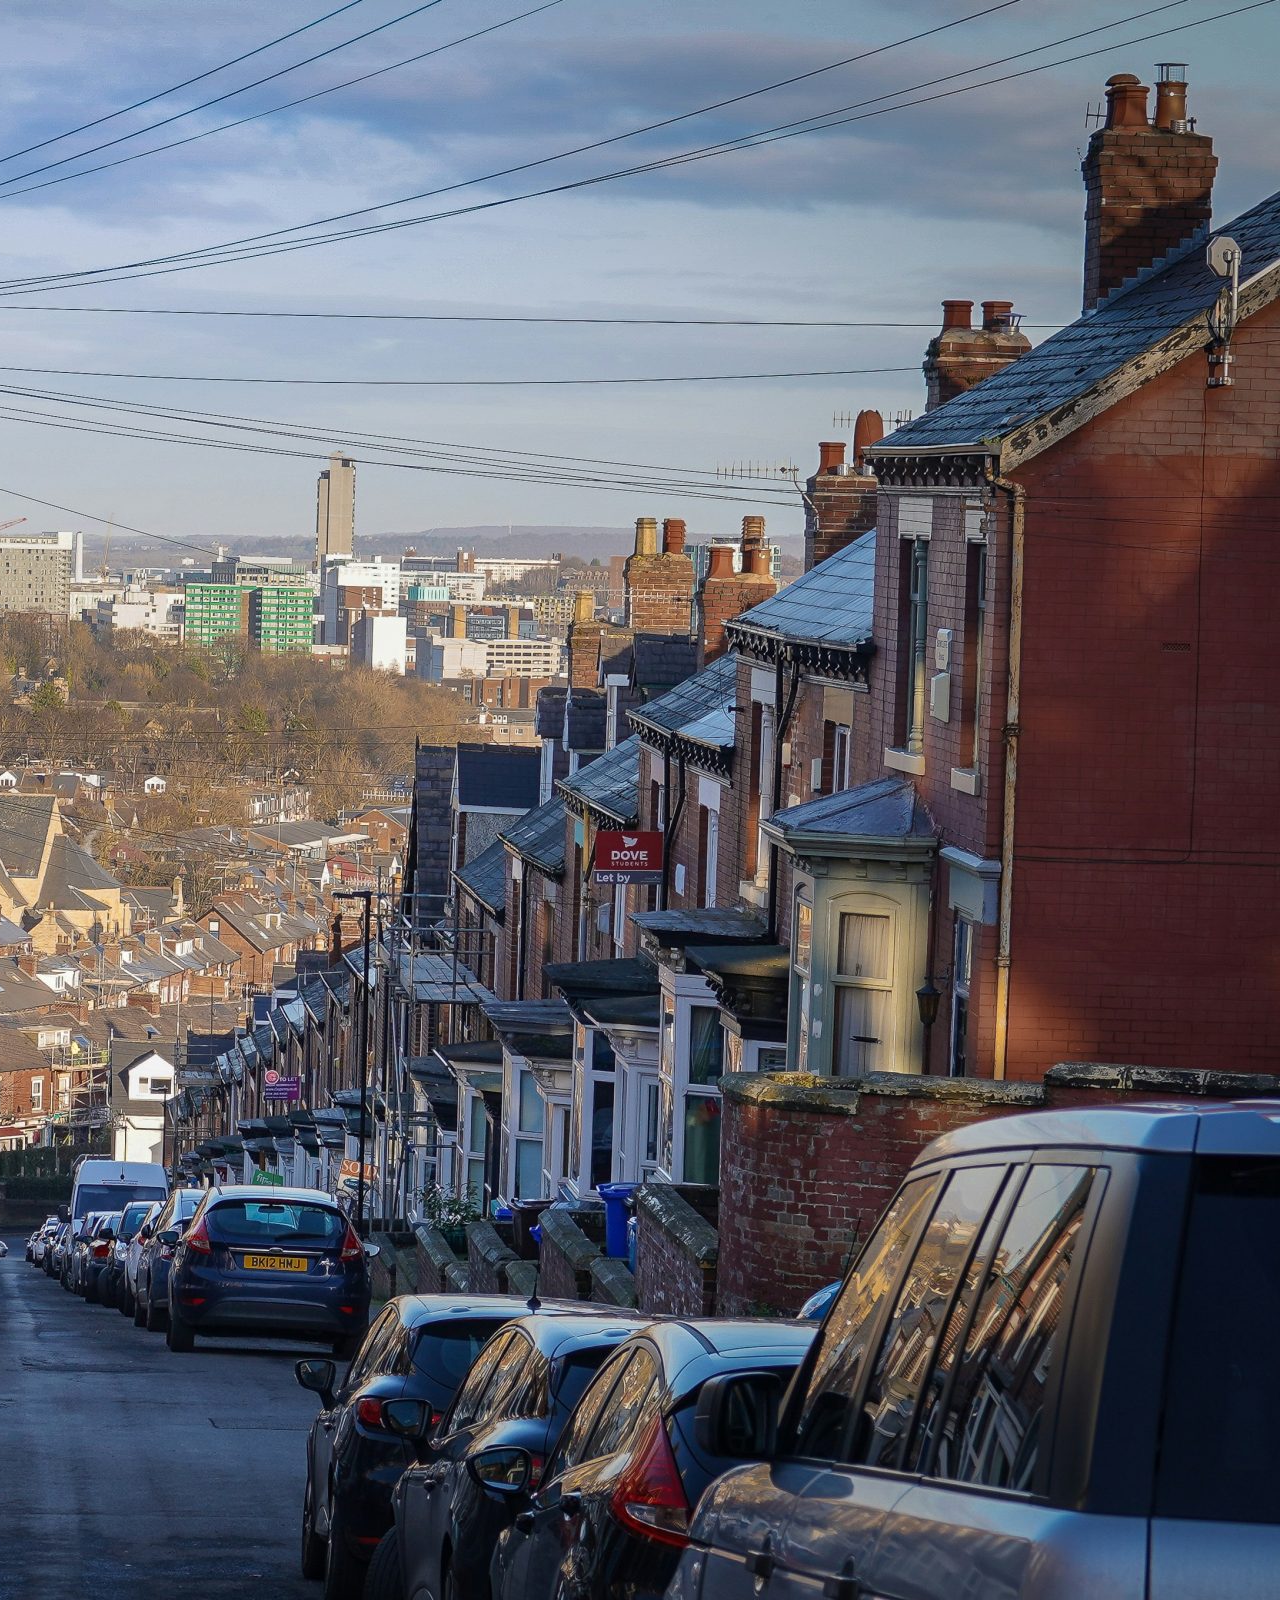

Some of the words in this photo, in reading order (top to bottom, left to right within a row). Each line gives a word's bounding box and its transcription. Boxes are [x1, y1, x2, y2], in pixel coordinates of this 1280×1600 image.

[611, 850, 649, 861] DOVE
[596, 873, 614, 882] Let
[617, 873, 631, 884] by
[251, 1257, 276, 1268] BK12
